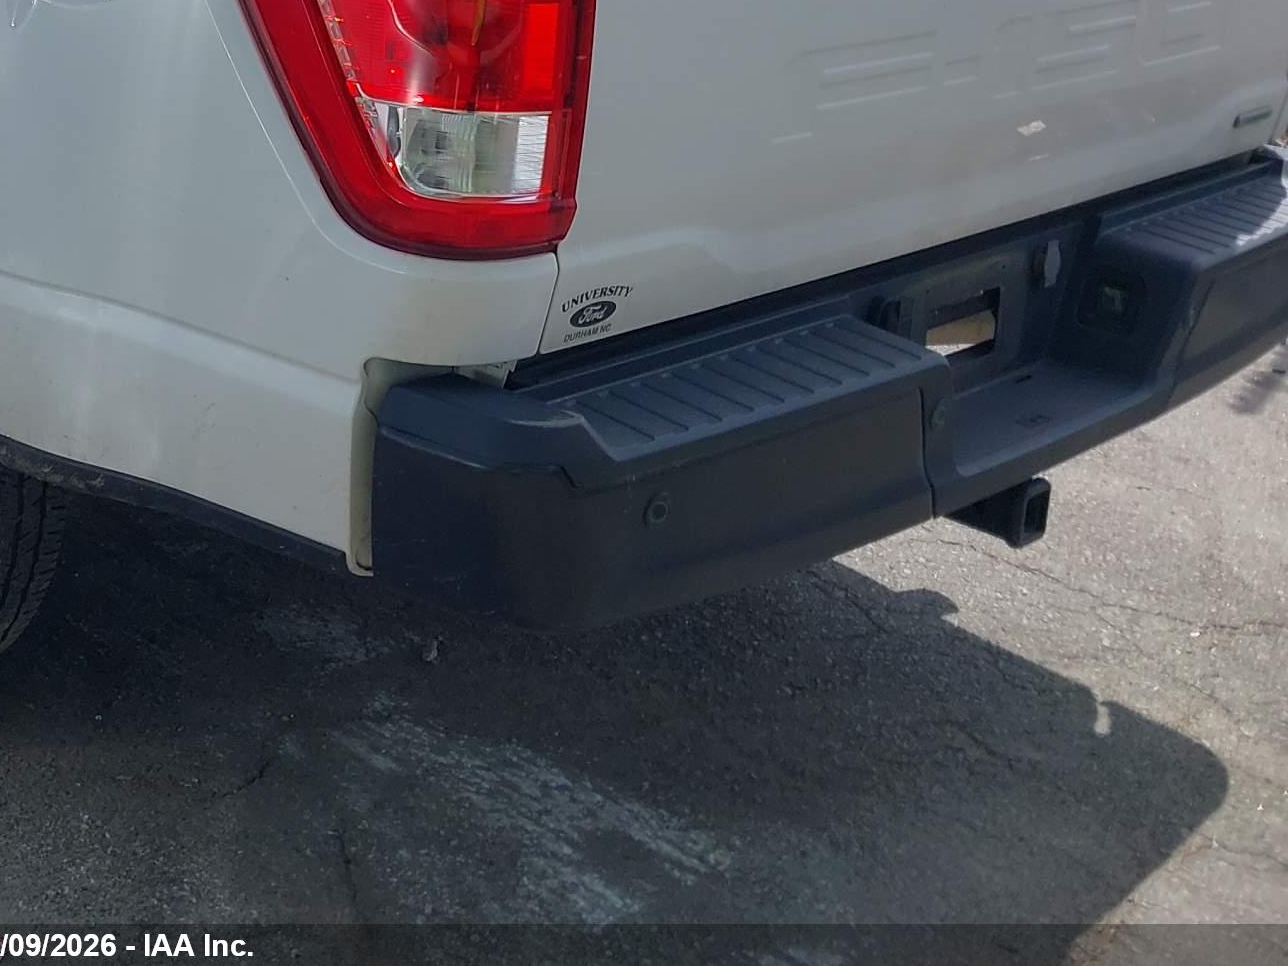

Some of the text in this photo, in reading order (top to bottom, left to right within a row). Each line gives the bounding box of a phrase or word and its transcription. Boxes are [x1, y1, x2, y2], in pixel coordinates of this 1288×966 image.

[561, 285, 633, 313] UNIVERSITY
[577, 304, 609, 325] Ford
[563, 323, 612, 343] DURHAM NC
